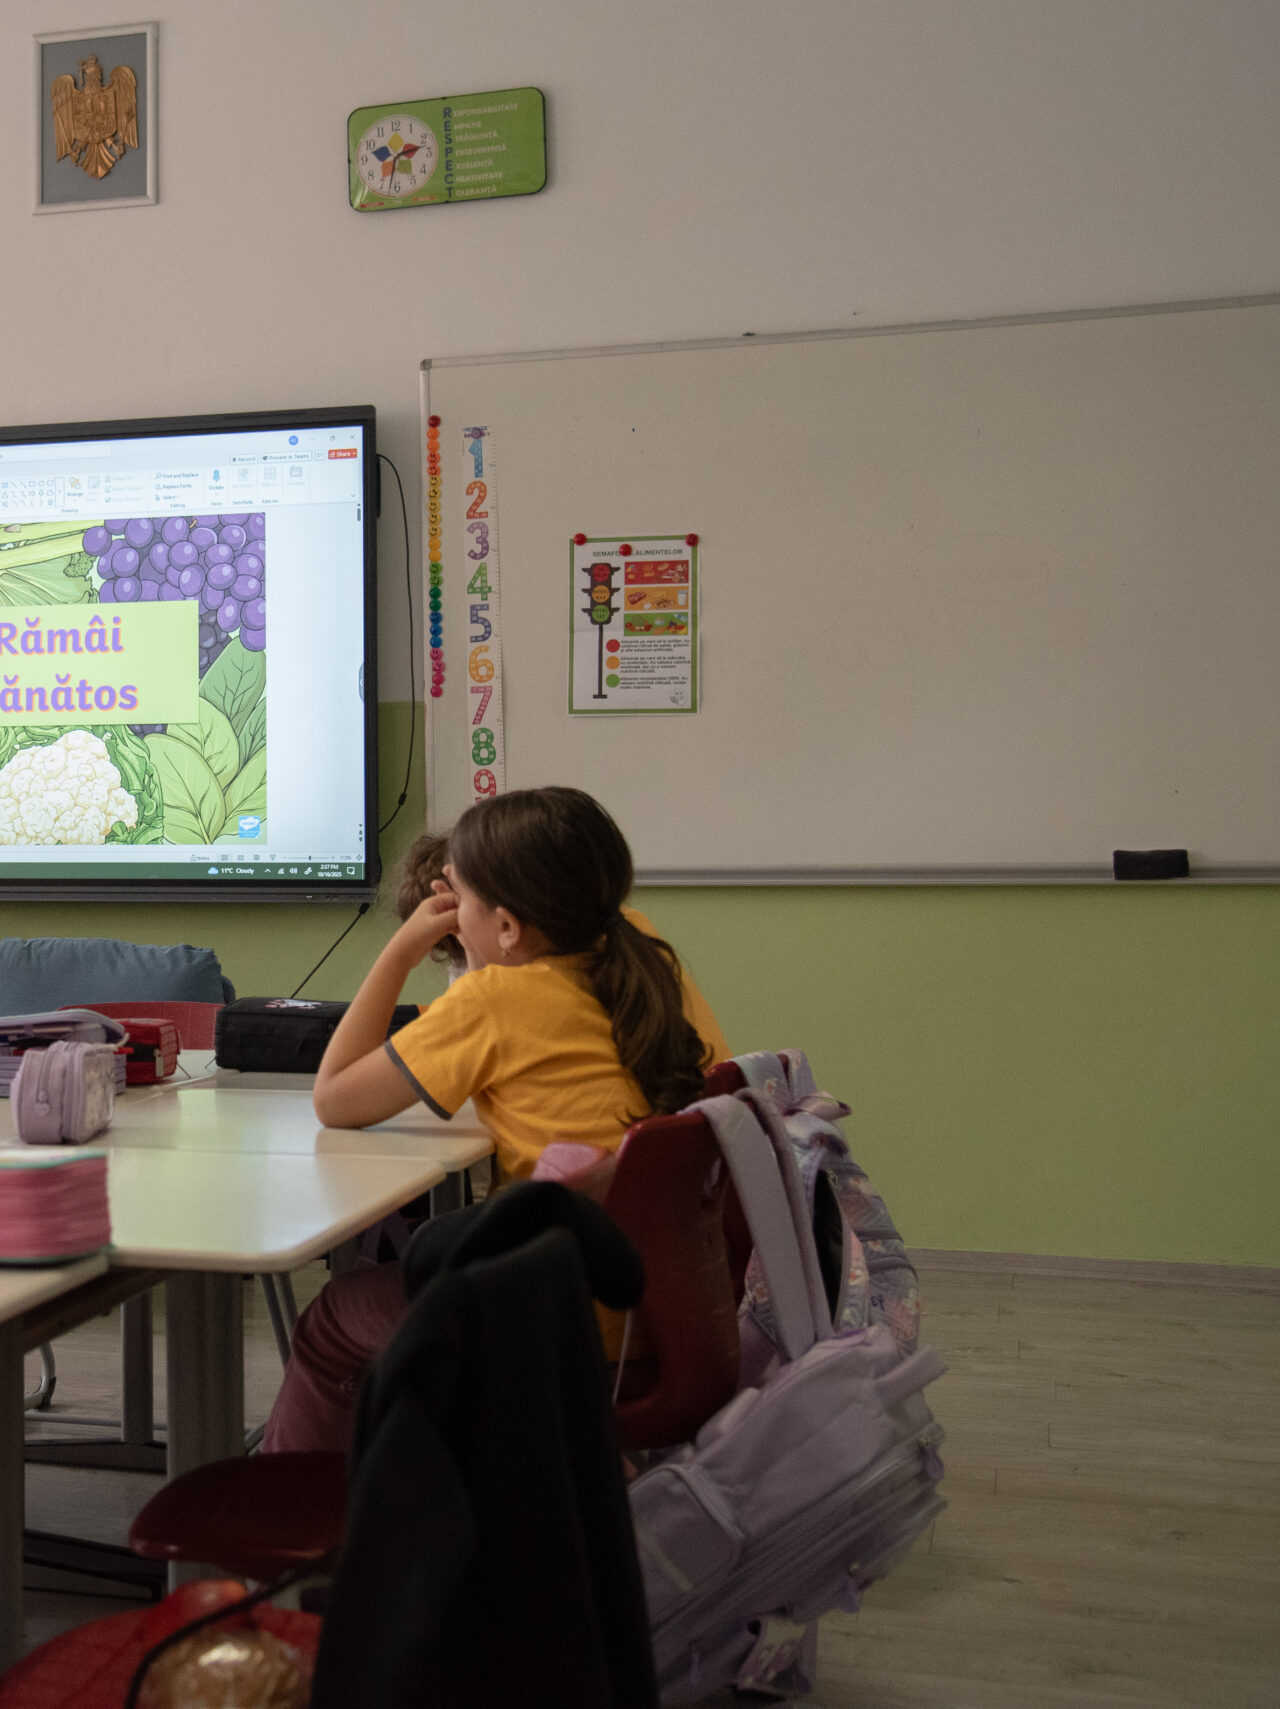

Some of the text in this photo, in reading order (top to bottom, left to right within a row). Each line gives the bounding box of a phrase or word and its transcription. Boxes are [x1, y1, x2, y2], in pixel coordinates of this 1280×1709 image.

[377, 126, 384, 138] 11
[391, 121, 400, 132] 12
[366, 139, 375, 150] 10
[420, 133, 427, 144] 2
[426, 147, 432, 158] 3
[443, 107, 454, 199] RESPECT
[361, 155, 368, 166] 9
[420, 163, 426, 175] 4
[367, 170, 374, 181] 8
[409, 176, 416, 186] 5
[379, 178, 385, 190] 7
[394, 181, 401, 193] 6
[468, 438, 484, 478] 1
[465, 480, 488, 519] 2
[467, 521, 489, 560] 3
[466, 562, 492, 601] 4
[469, 604, 492, 643] 5
[468, 645, 495, 684] 6
[470, 685, 493, 725] 7
[471, 727, 497, 766] 8
[473, 769, 497, 802] 9
[236, 867, 255, 875] Cloudy
